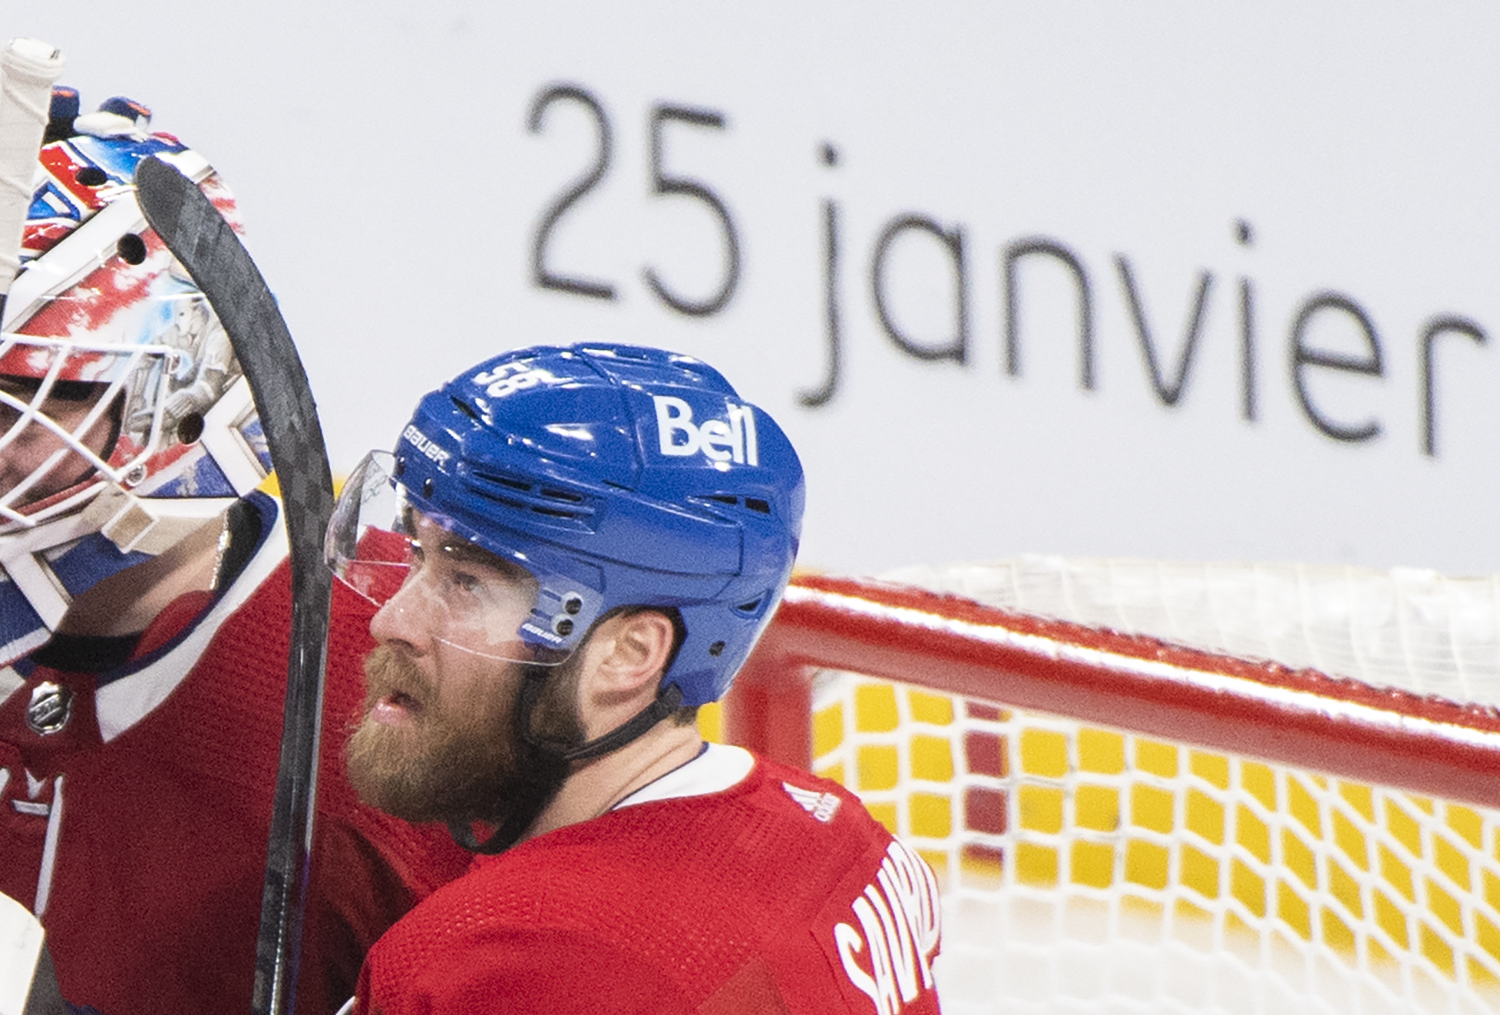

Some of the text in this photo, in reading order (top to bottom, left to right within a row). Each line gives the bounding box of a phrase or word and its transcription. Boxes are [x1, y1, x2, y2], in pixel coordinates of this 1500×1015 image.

[523, 80, 1490, 460] 25 janvier
[471, 361, 540, 398] 58
[652, 395, 759, 467] Bell
